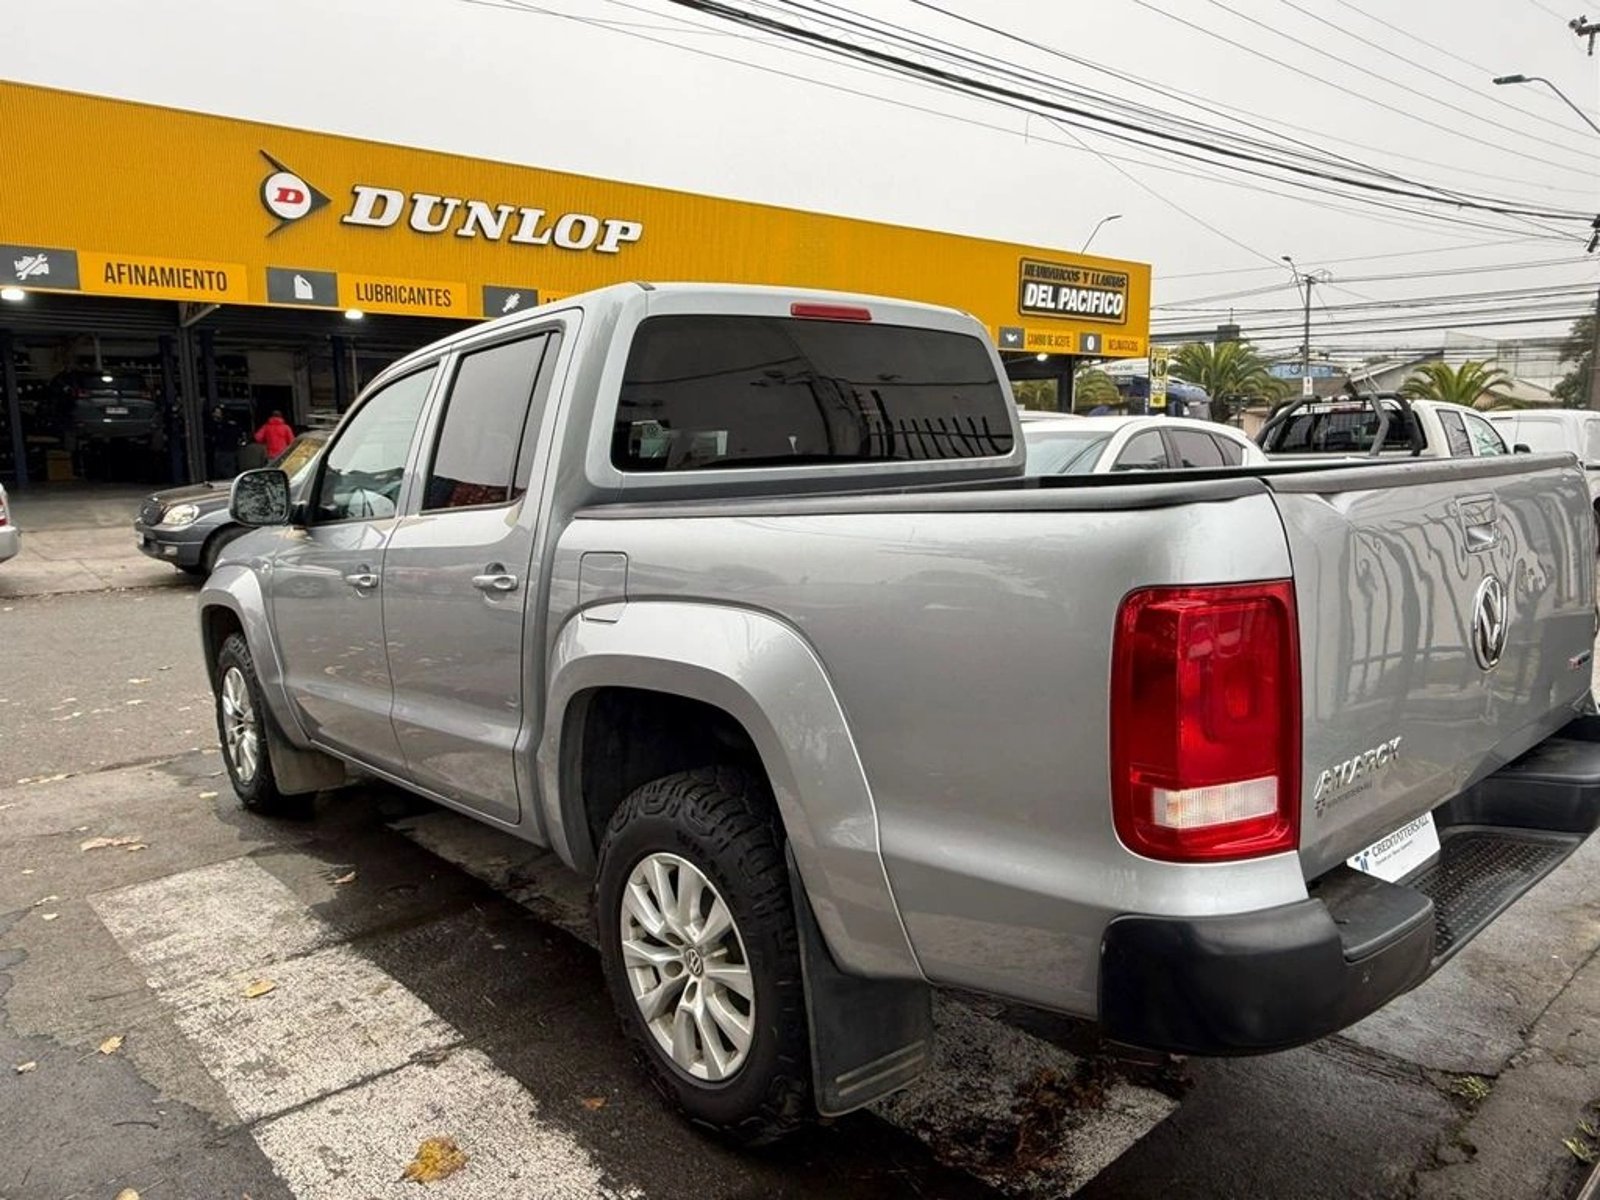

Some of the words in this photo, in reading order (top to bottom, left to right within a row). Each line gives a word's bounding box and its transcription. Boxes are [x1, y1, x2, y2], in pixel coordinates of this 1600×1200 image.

[274, 187, 305, 205] D
[341, 184, 643, 253] DUNLOP
[104, 261, 227, 292] AFINAMIENTO
[356, 282, 452, 307] LUBRICANTES
[1023, 282, 1056, 309] DEL
[1057, 286, 1124, 316] PACIFICO
